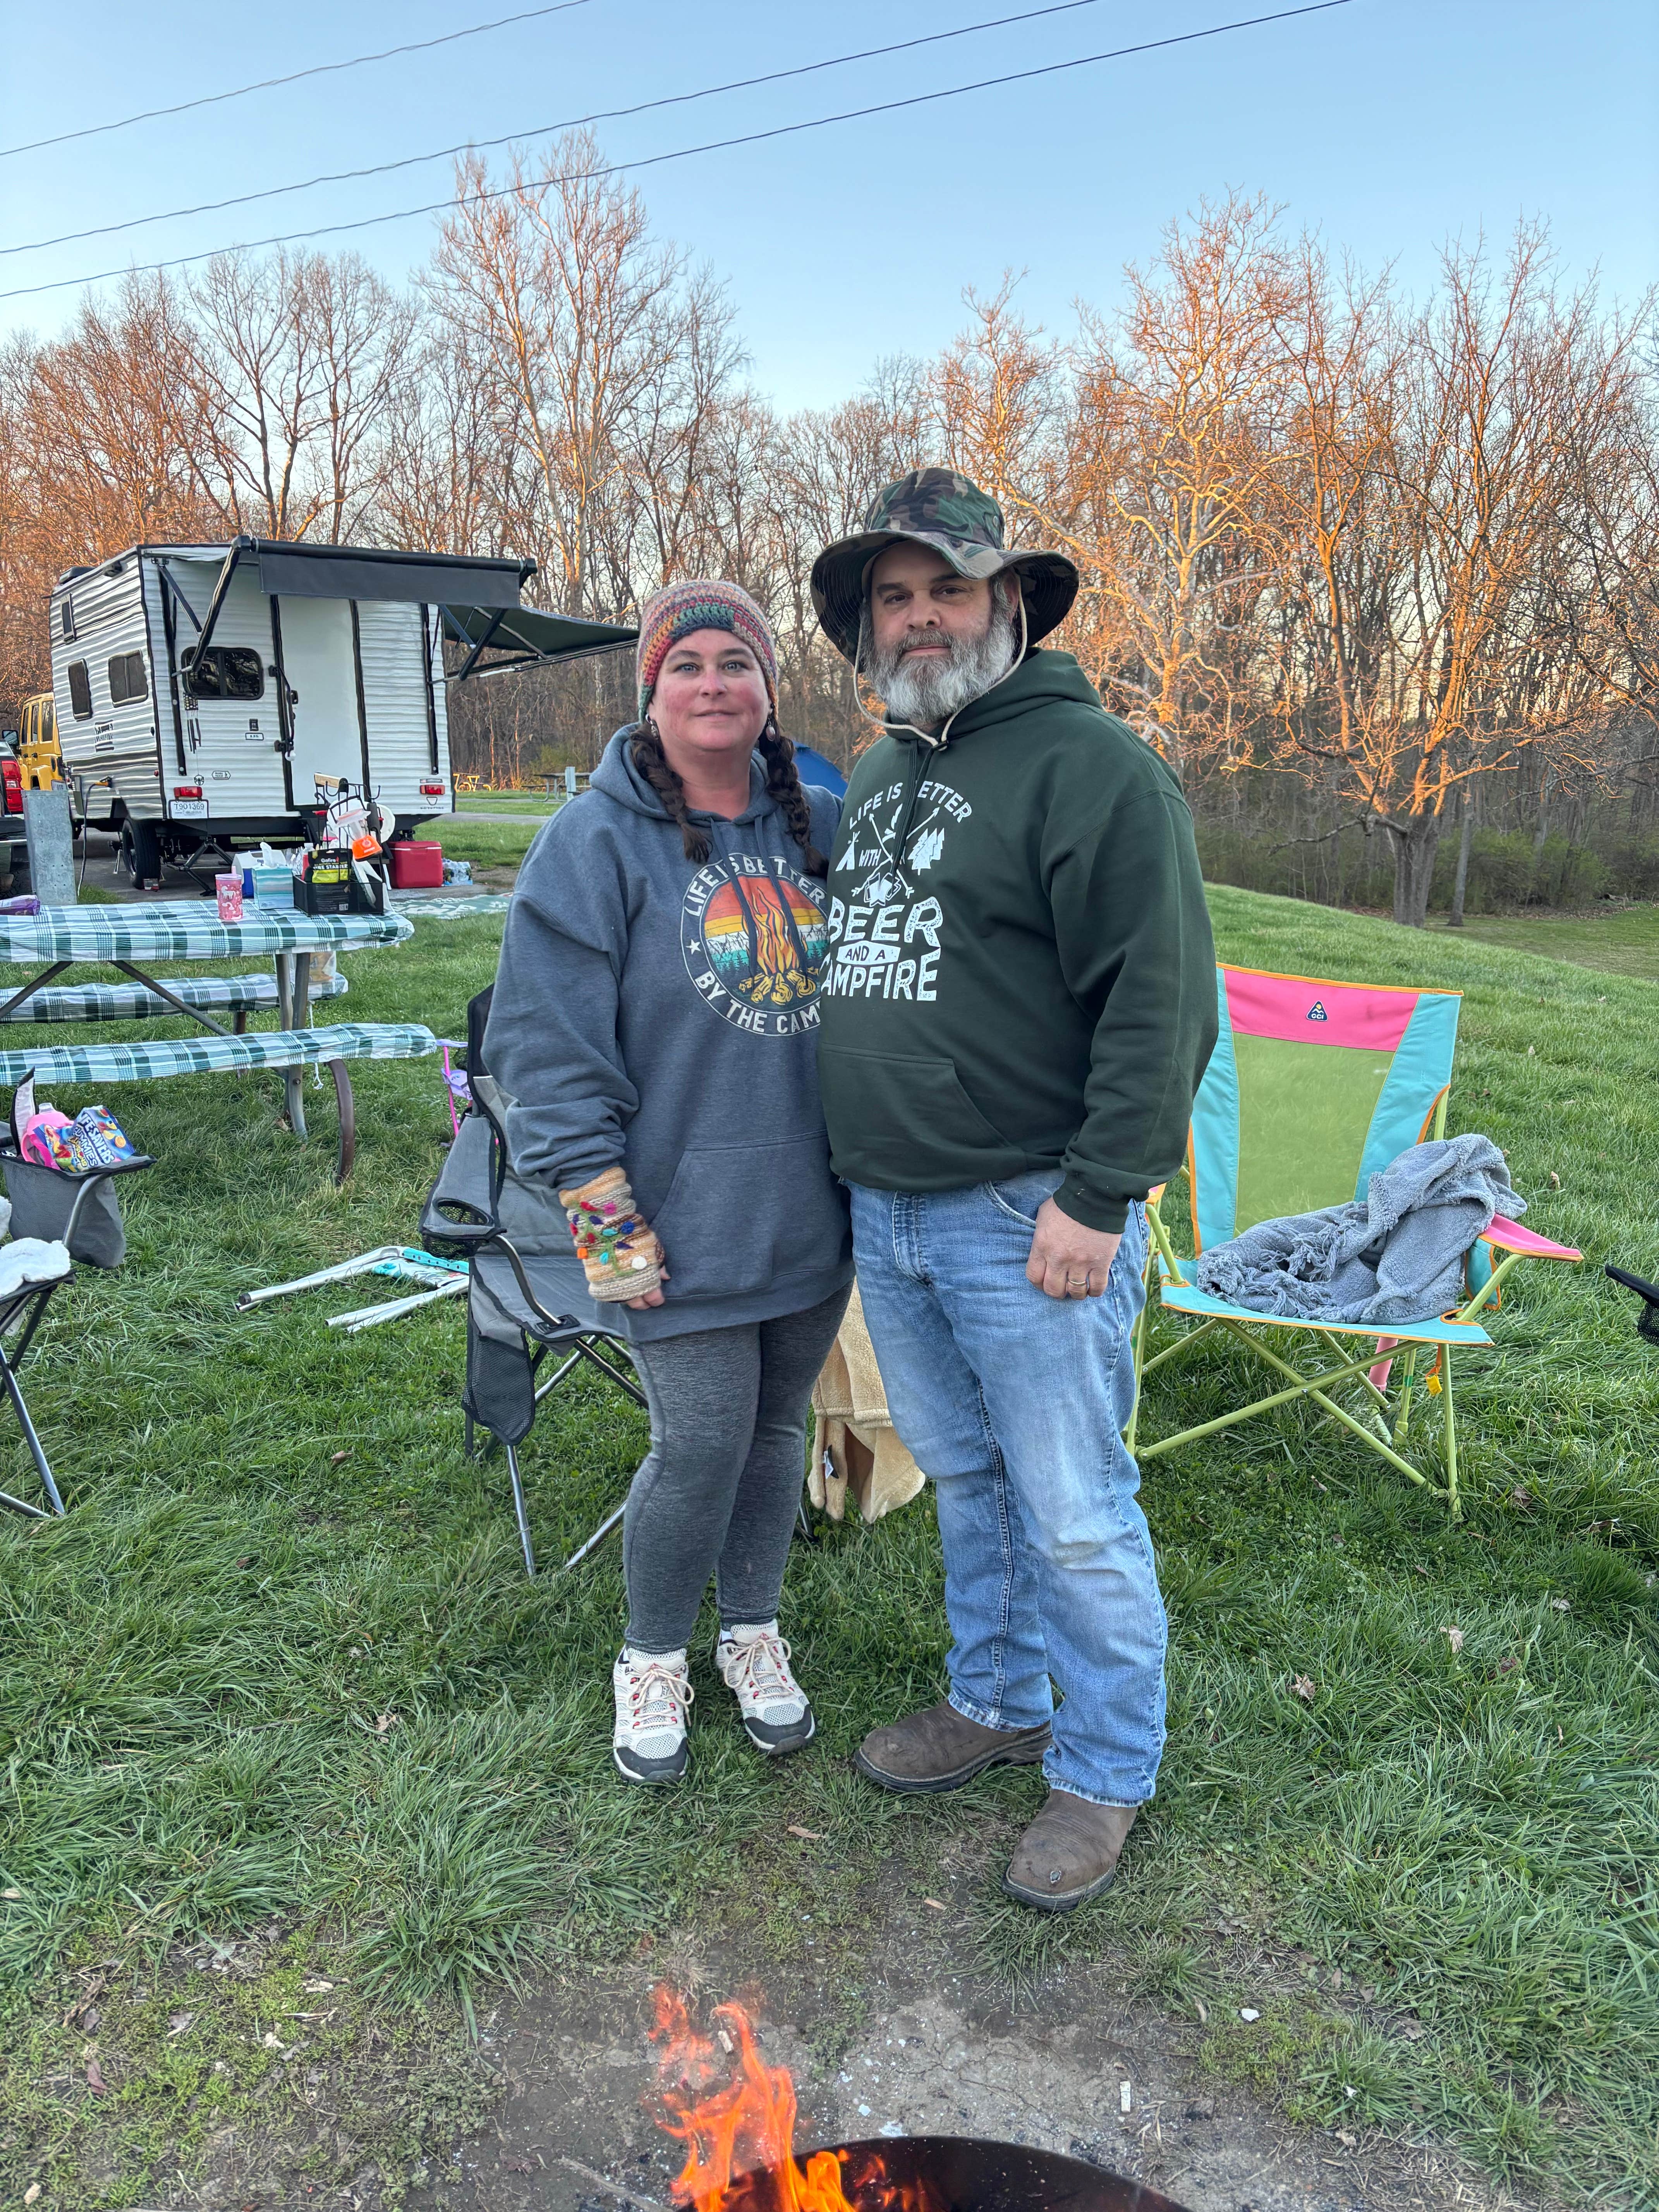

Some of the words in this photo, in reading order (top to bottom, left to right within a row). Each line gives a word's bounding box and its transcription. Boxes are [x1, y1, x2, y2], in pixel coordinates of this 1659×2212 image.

[849, 790, 884, 830] LIFE
[886, 782, 903, 802] IS
[917, 780, 972, 823] ETTER
[858, 848, 881, 867] WITH
[684, 868, 719, 916] LIFE
[743, 856, 825, 905] BETTER
[828, 896, 943, 948] BEER
[845, 945, 869, 961] AND
[874, 949, 886, 961] A
[695, 971, 726, 1001] BY
[725, 999, 768, 1033] THE
[776, 1000, 821, 1034] CAM
[73, 1126, 97, 1167] GUMMIES
